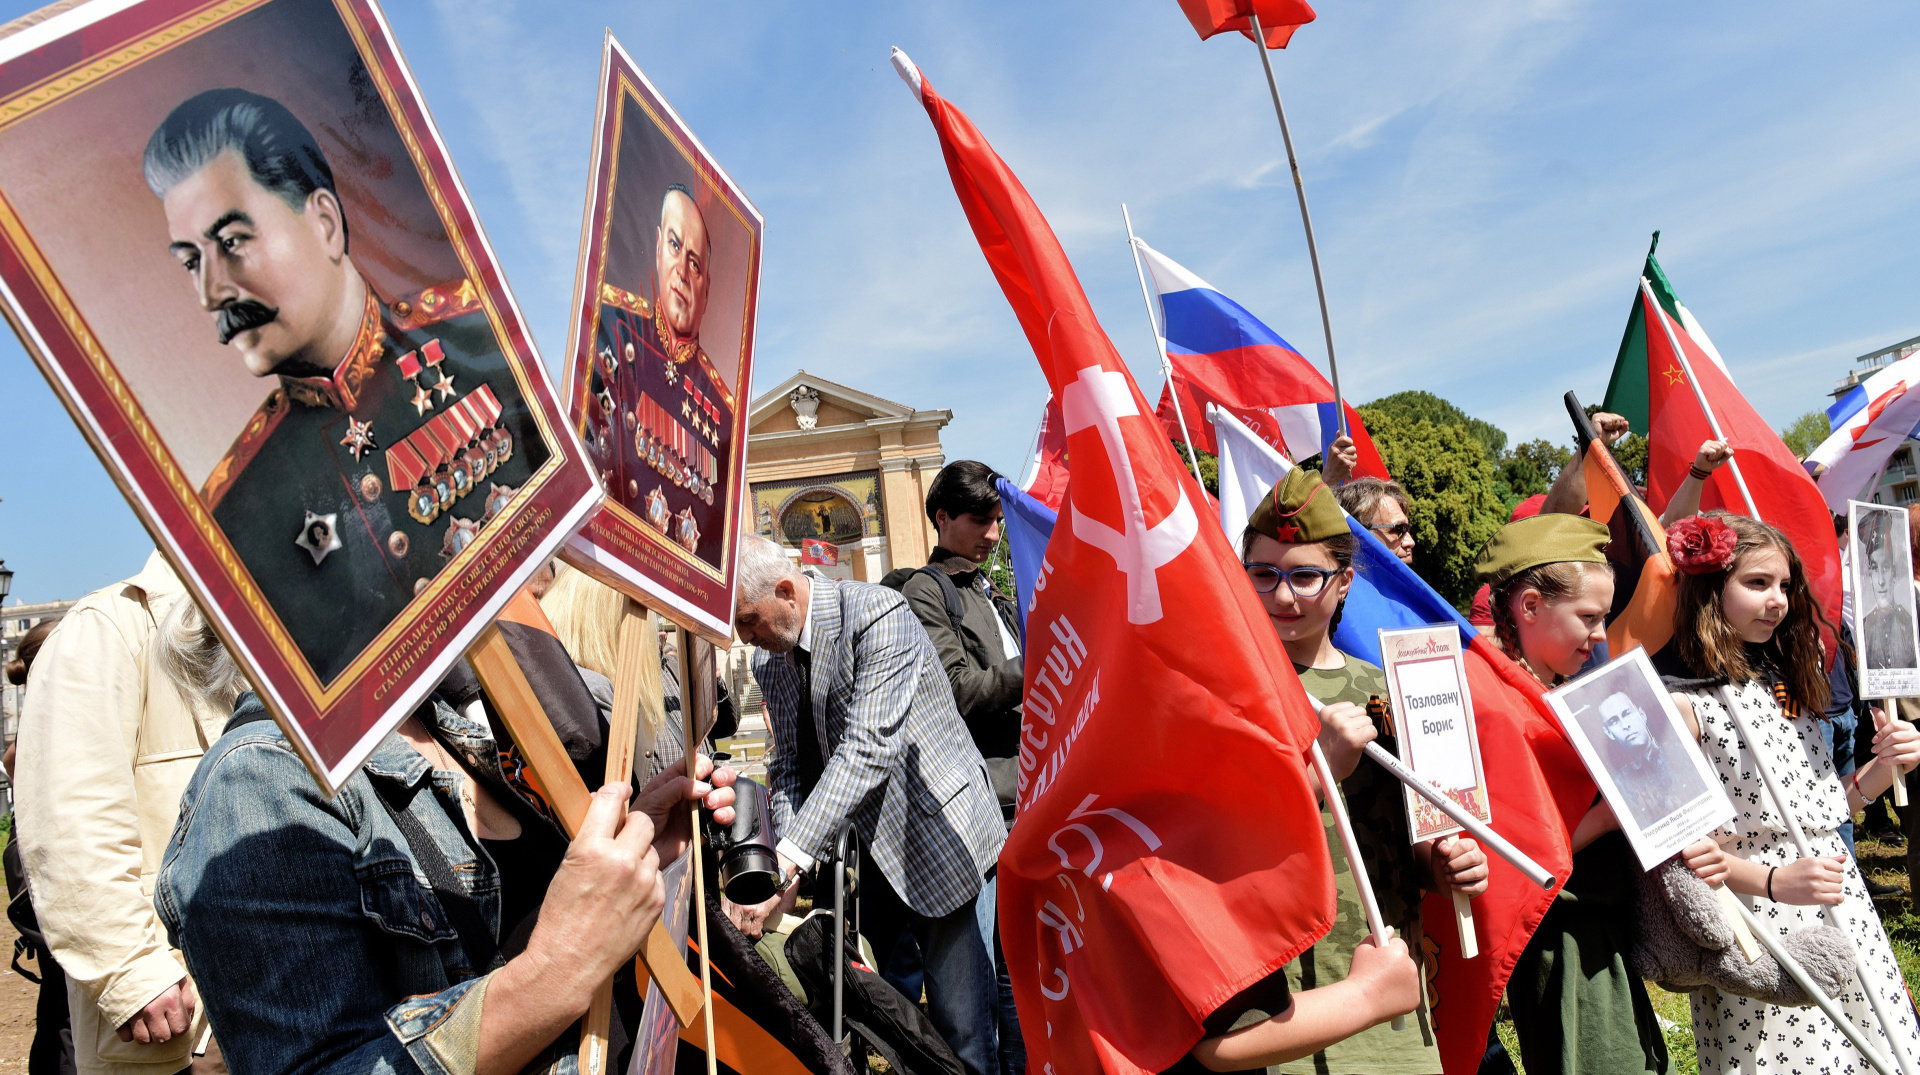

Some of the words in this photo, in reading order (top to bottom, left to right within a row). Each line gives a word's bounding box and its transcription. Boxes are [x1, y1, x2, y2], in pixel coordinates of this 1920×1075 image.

[613, 522, 639, 545] МАРШАЛ
[636, 539, 671, 566] СОВЕТСКОГО
[670, 560, 689, 578] СОЮЗА
[374, 655, 415, 701] СТАЛИН
[413, 620, 447, 659] ИОСИФ
[447, 545, 516, 624] ВИССАРИОНОВИЧ
[517, 507, 552, 550] (1879-1953)
[379, 587, 458, 676] ГЕНЕРАЛИССИМУС
[461, 534, 510, 588] СОВЕТСКОГО
[509, 506, 537, 537] СОЮЗА
[1405, 691, 1459, 710] Тозловану
[1422, 718, 1454, 736] Борис
